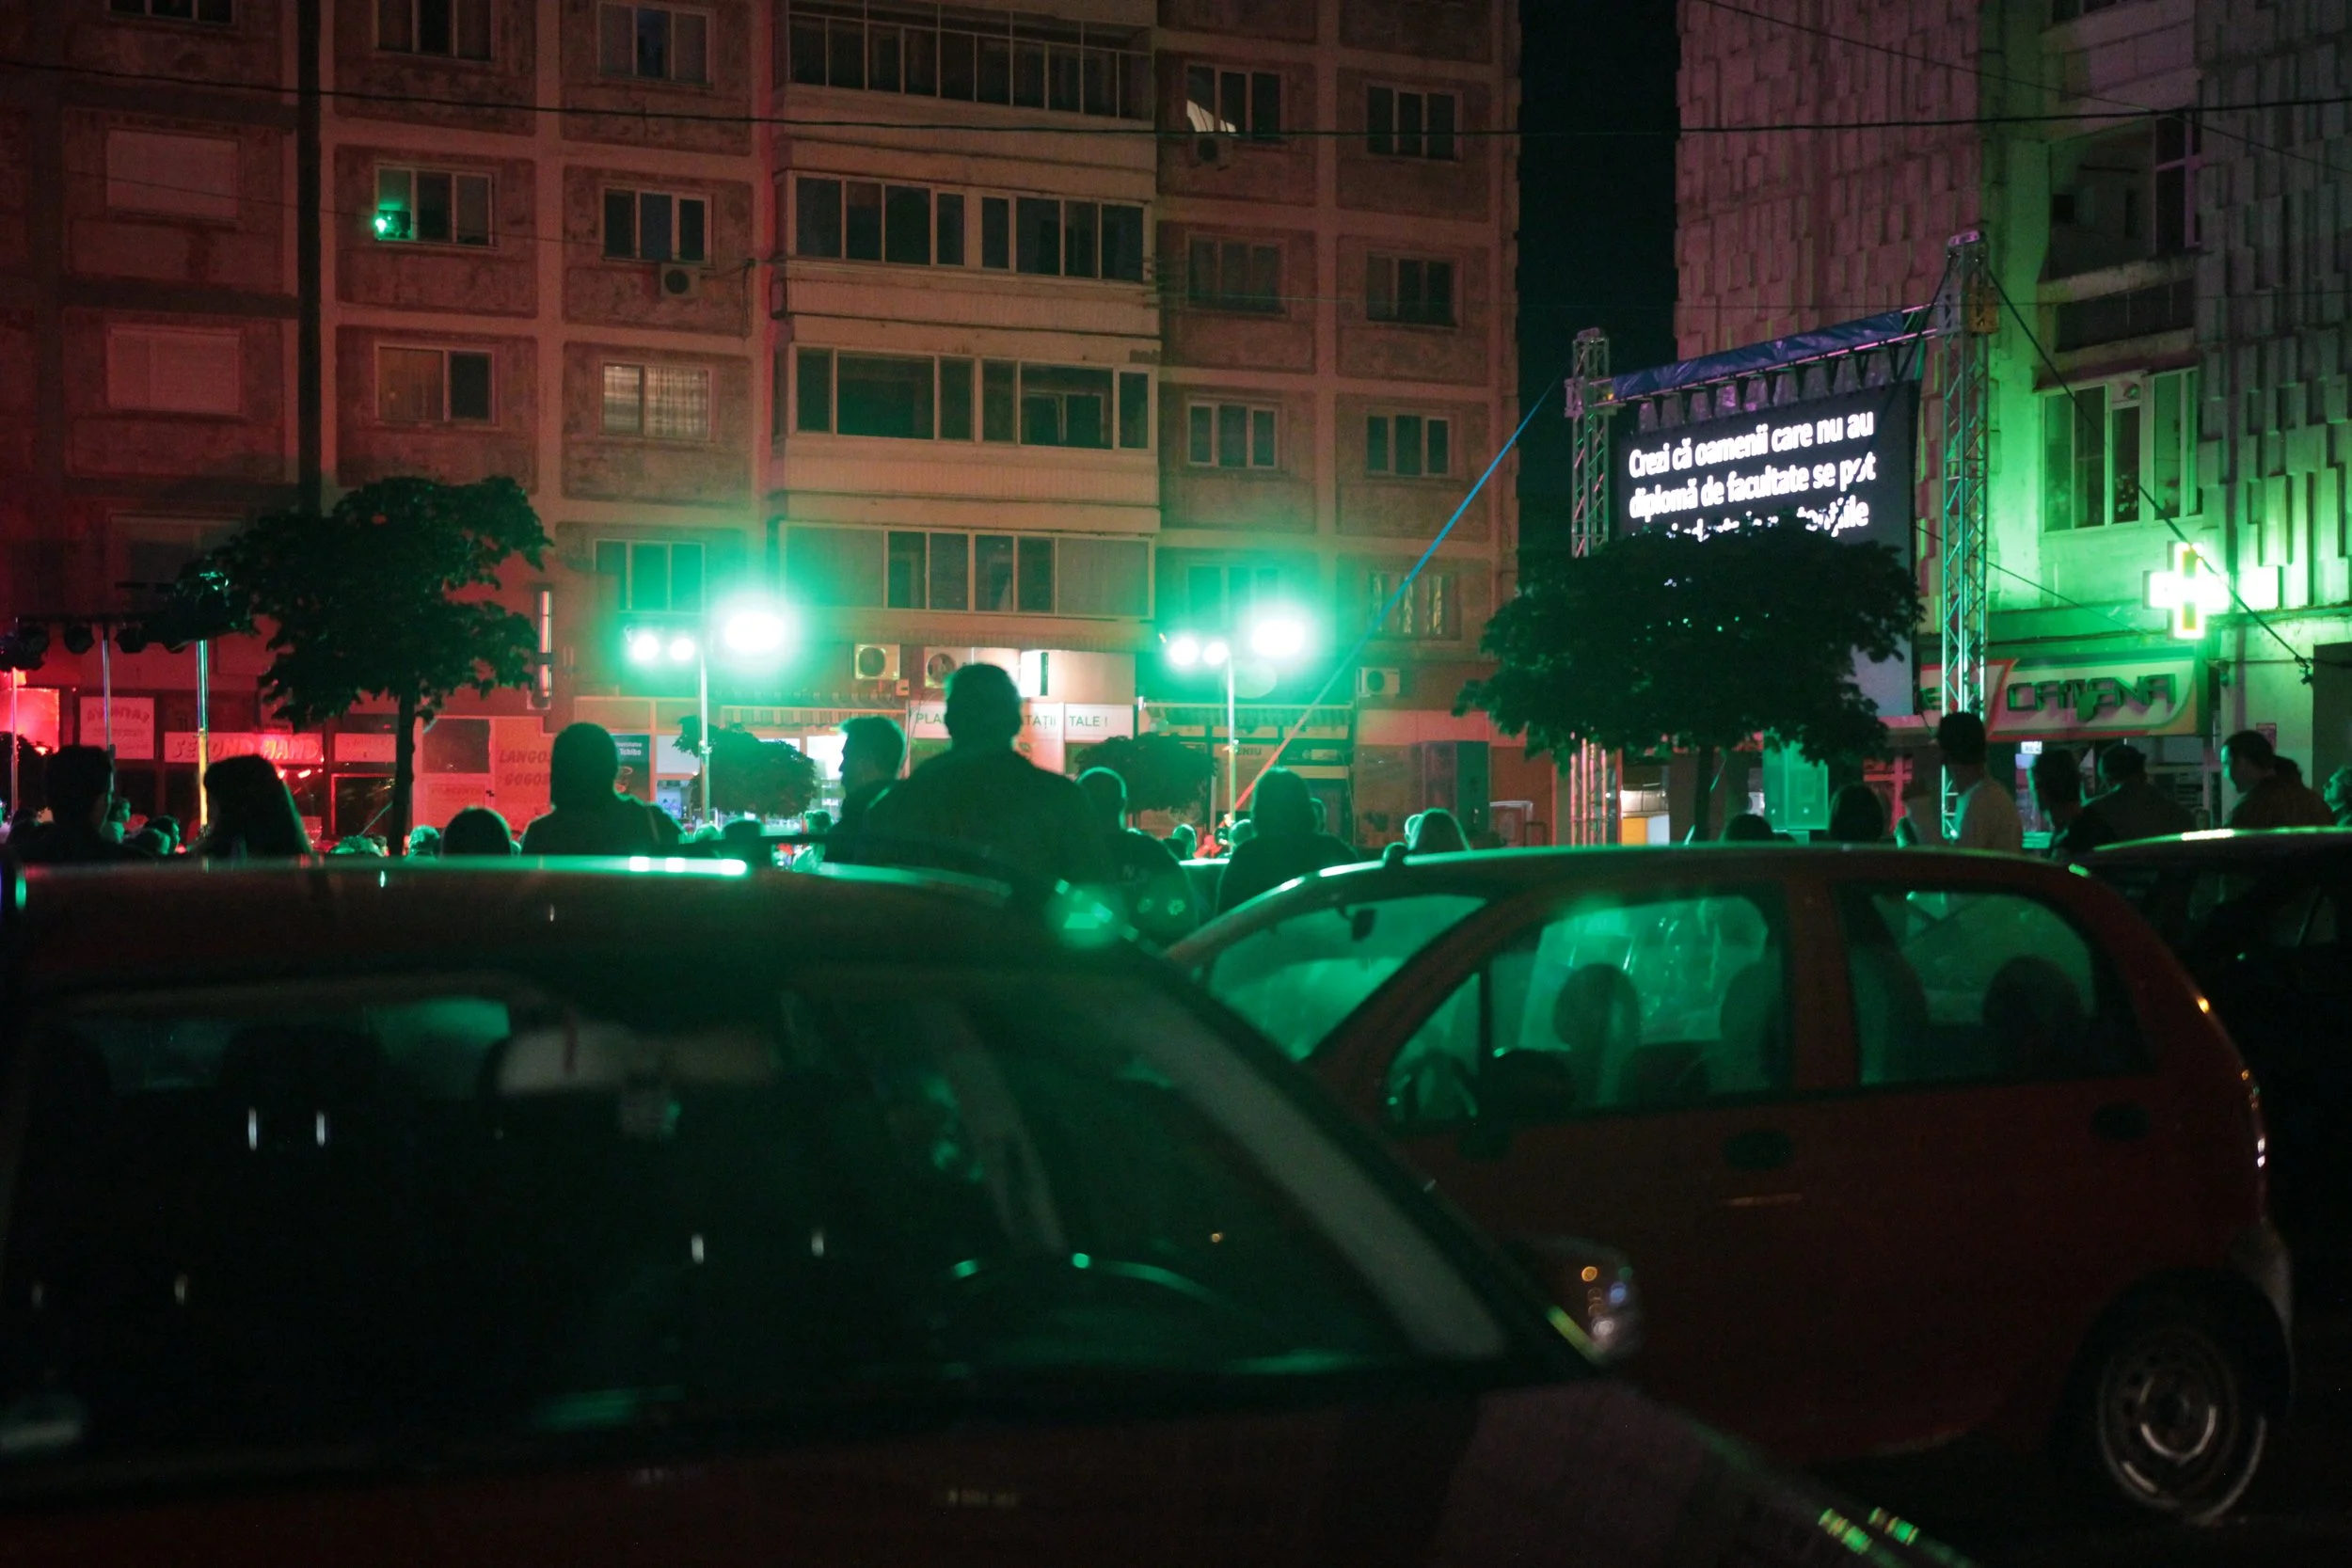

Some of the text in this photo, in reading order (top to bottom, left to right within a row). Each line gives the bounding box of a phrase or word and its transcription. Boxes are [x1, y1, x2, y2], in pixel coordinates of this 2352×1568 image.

[1629, 411, 1874, 479] Crezi că oamenii care nu au
[1629, 478, 1698, 523] diplomă
[1700, 475, 1724, 508] de
[1726, 464, 1809, 502] facultate
[1812, 463, 1836, 489] se
[2007, 673, 2177, 721] CATENA
[1070, 715, 1101, 727] TALE
[172, 737, 255, 759] SEOND
[260, 737, 320, 760] HAND
[499, 750, 549, 764] LANGO
[619, 748, 643, 756] Tchibo
